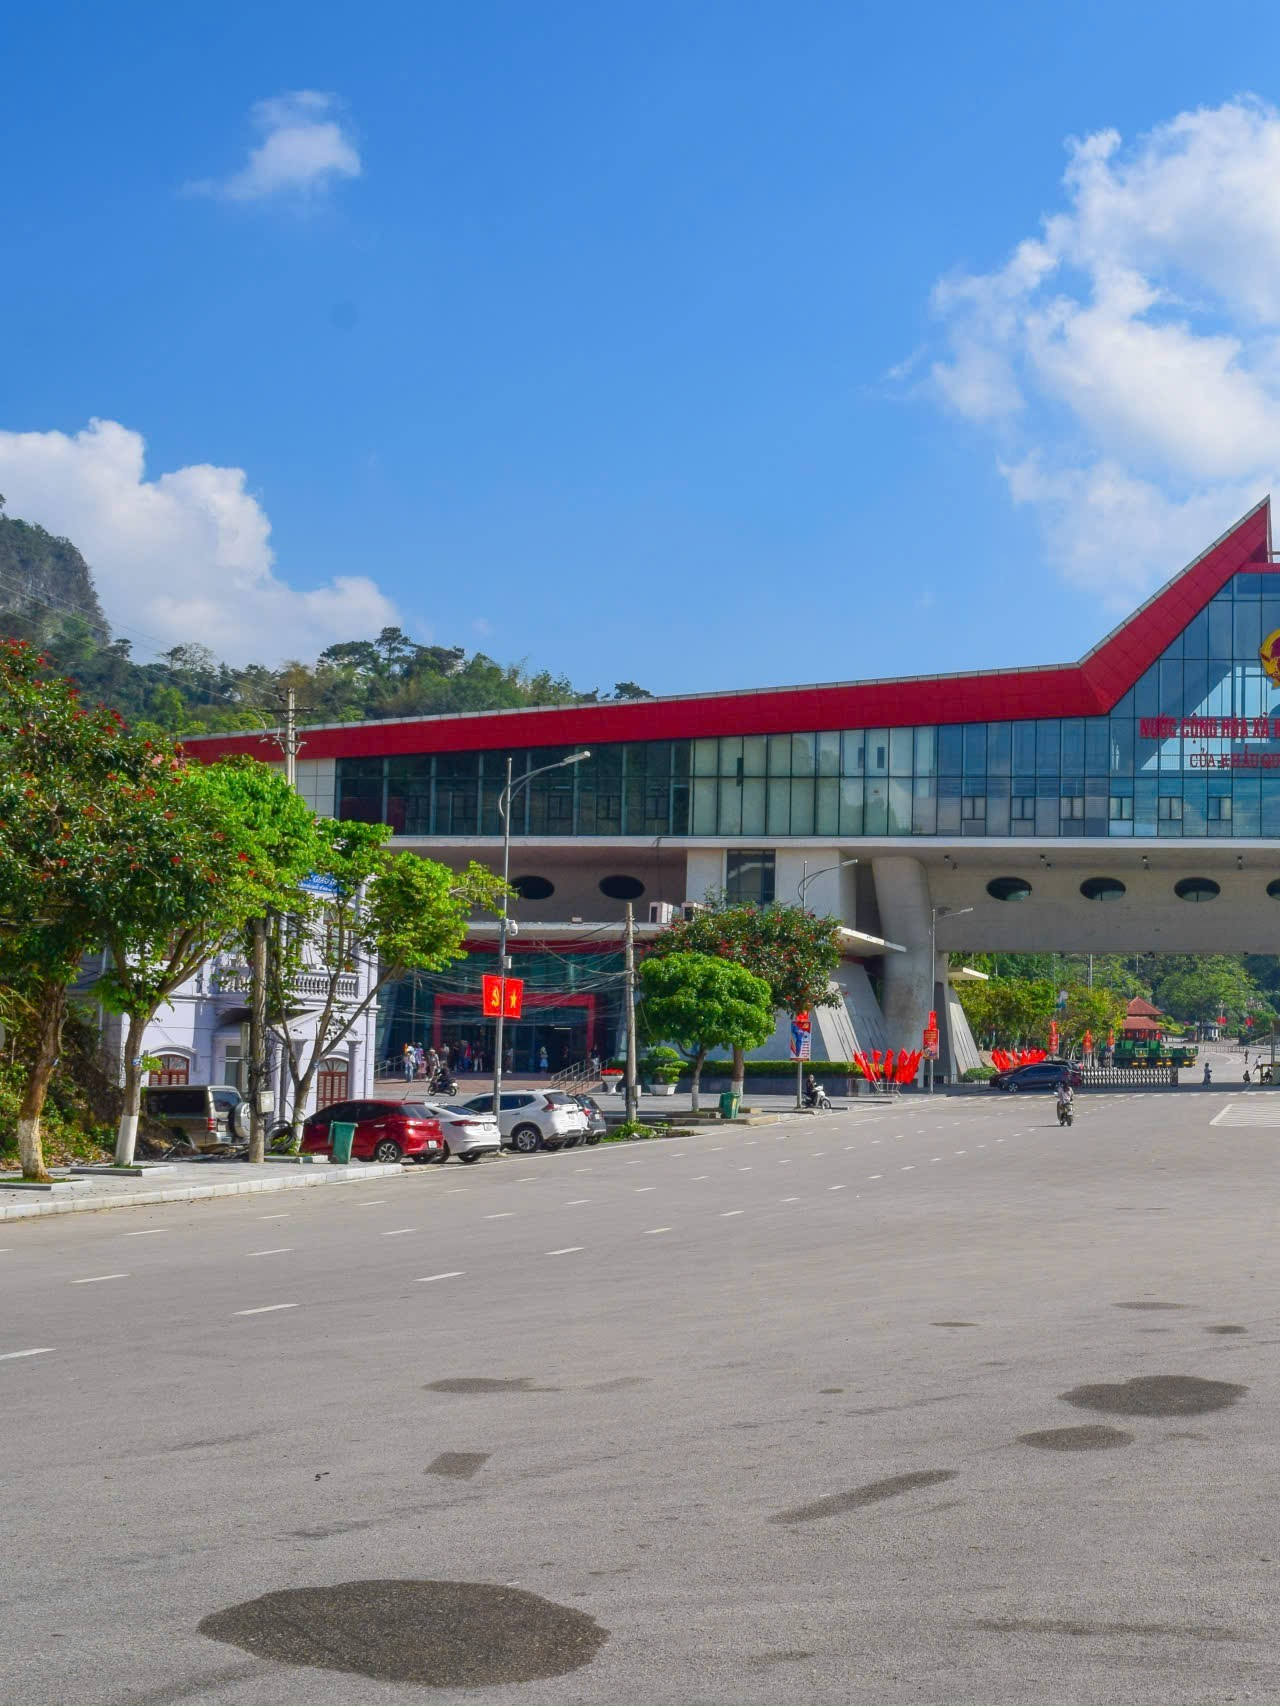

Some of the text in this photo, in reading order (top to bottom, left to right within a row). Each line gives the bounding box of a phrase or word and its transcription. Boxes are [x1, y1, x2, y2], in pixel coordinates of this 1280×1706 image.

[1139, 713, 1177, 738] NƯỚC
[1181, 712, 1217, 743] CỘNG
[1252, 711, 1269, 738] XÃ
[1189, 747, 1216, 768] CỬA
